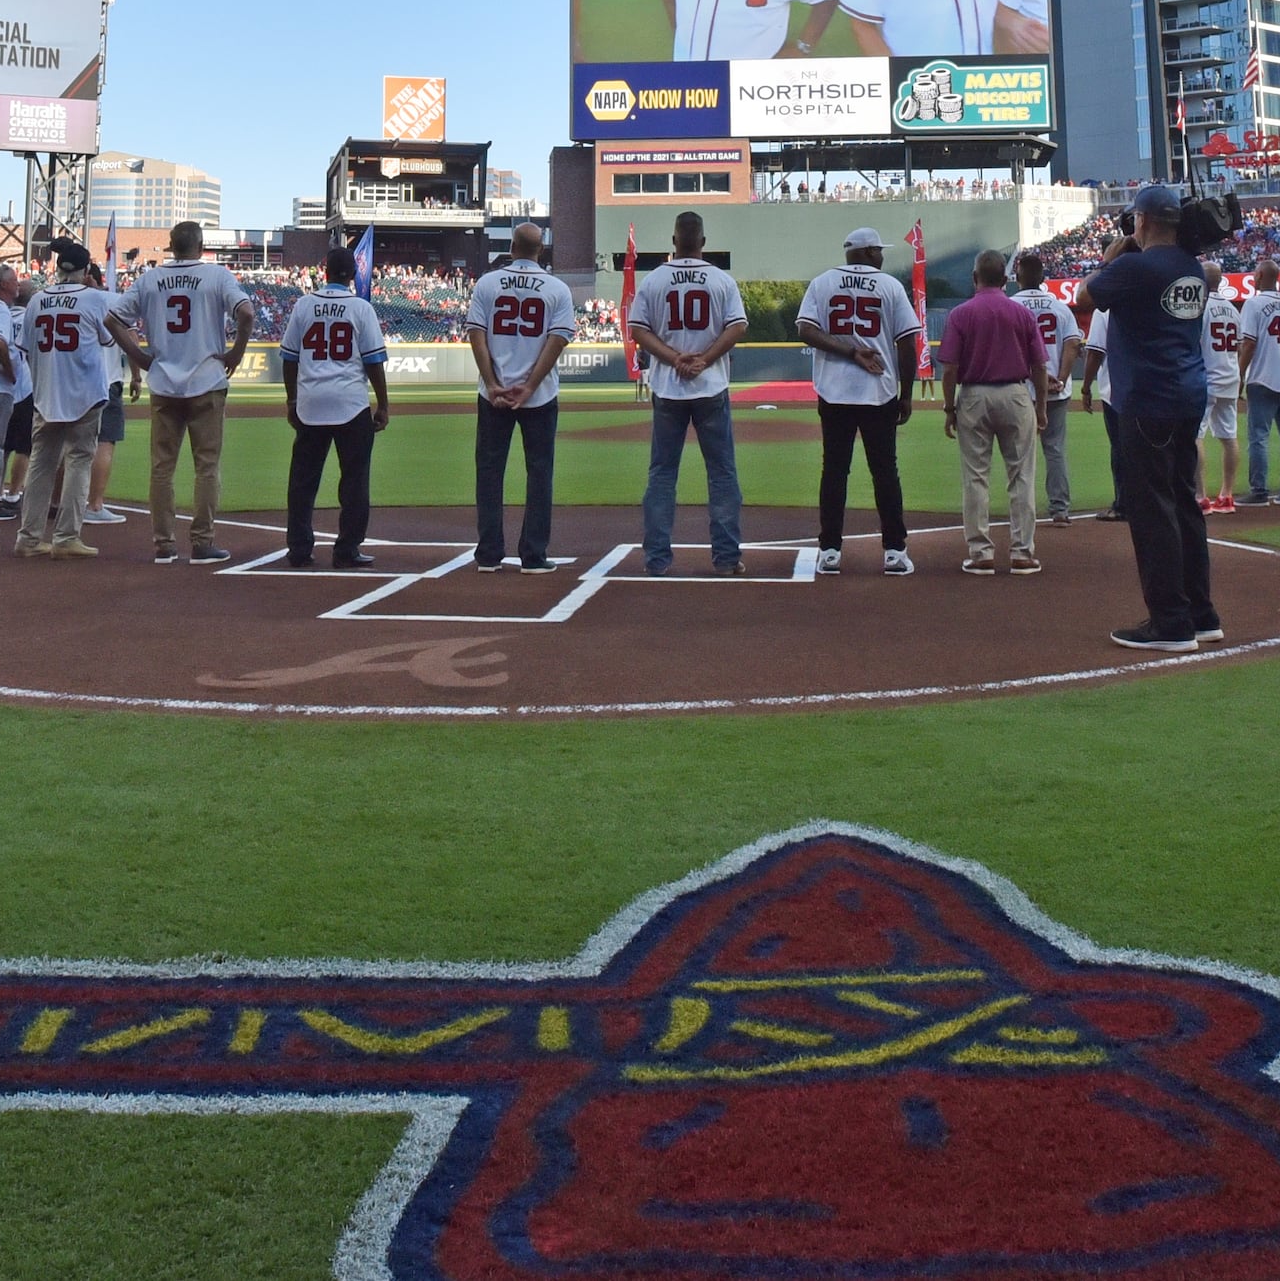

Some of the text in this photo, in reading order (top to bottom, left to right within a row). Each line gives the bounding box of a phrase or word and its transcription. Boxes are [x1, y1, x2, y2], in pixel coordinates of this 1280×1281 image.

[965, 72, 1042, 89] MAVIS
[391, 84, 416, 109] THE
[594, 89, 719, 110] NAPA KNOW HOW
[739, 84, 882, 101] NORTHSIDE
[965, 91, 1042, 105] DISCOUNT
[384, 77, 445, 138] HOME
[765, 104, 856, 116] HOSPITAL
[978, 107, 1030, 121] TIRE
[9, 117, 66, 129] CHEROKEE
[408, 102, 444, 139] DEPOT
[9, 129, 66, 139] CASINOS
[603, 153, 624, 162] HOME
[626, 153, 636, 161] OF
[636, 153, 651, 161] THE
[653, 153, 669, 161] 2021
[718, 152, 740, 160] GAME
[157, 275, 202, 292] MURPHY
[500, 276, 545, 293] SMOLTZ
[670, 271, 708, 285] JONES
[839, 276, 877, 292] JONES
[1173, 285, 1202, 303] FOX
[40, 296, 78, 310] NIEKRO
[314, 303, 346, 318] GARR
[666, 290, 710, 331] 10
[1023, 300, 1053, 310] PEREZ
[166, 295, 191, 334] 3
[493, 296, 545, 338] 29
[829, 295, 882, 338] 25
[35, 314, 80, 353] 35
[303, 322, 353, 361] 48
[1210, 322, 1237, 352] 52
